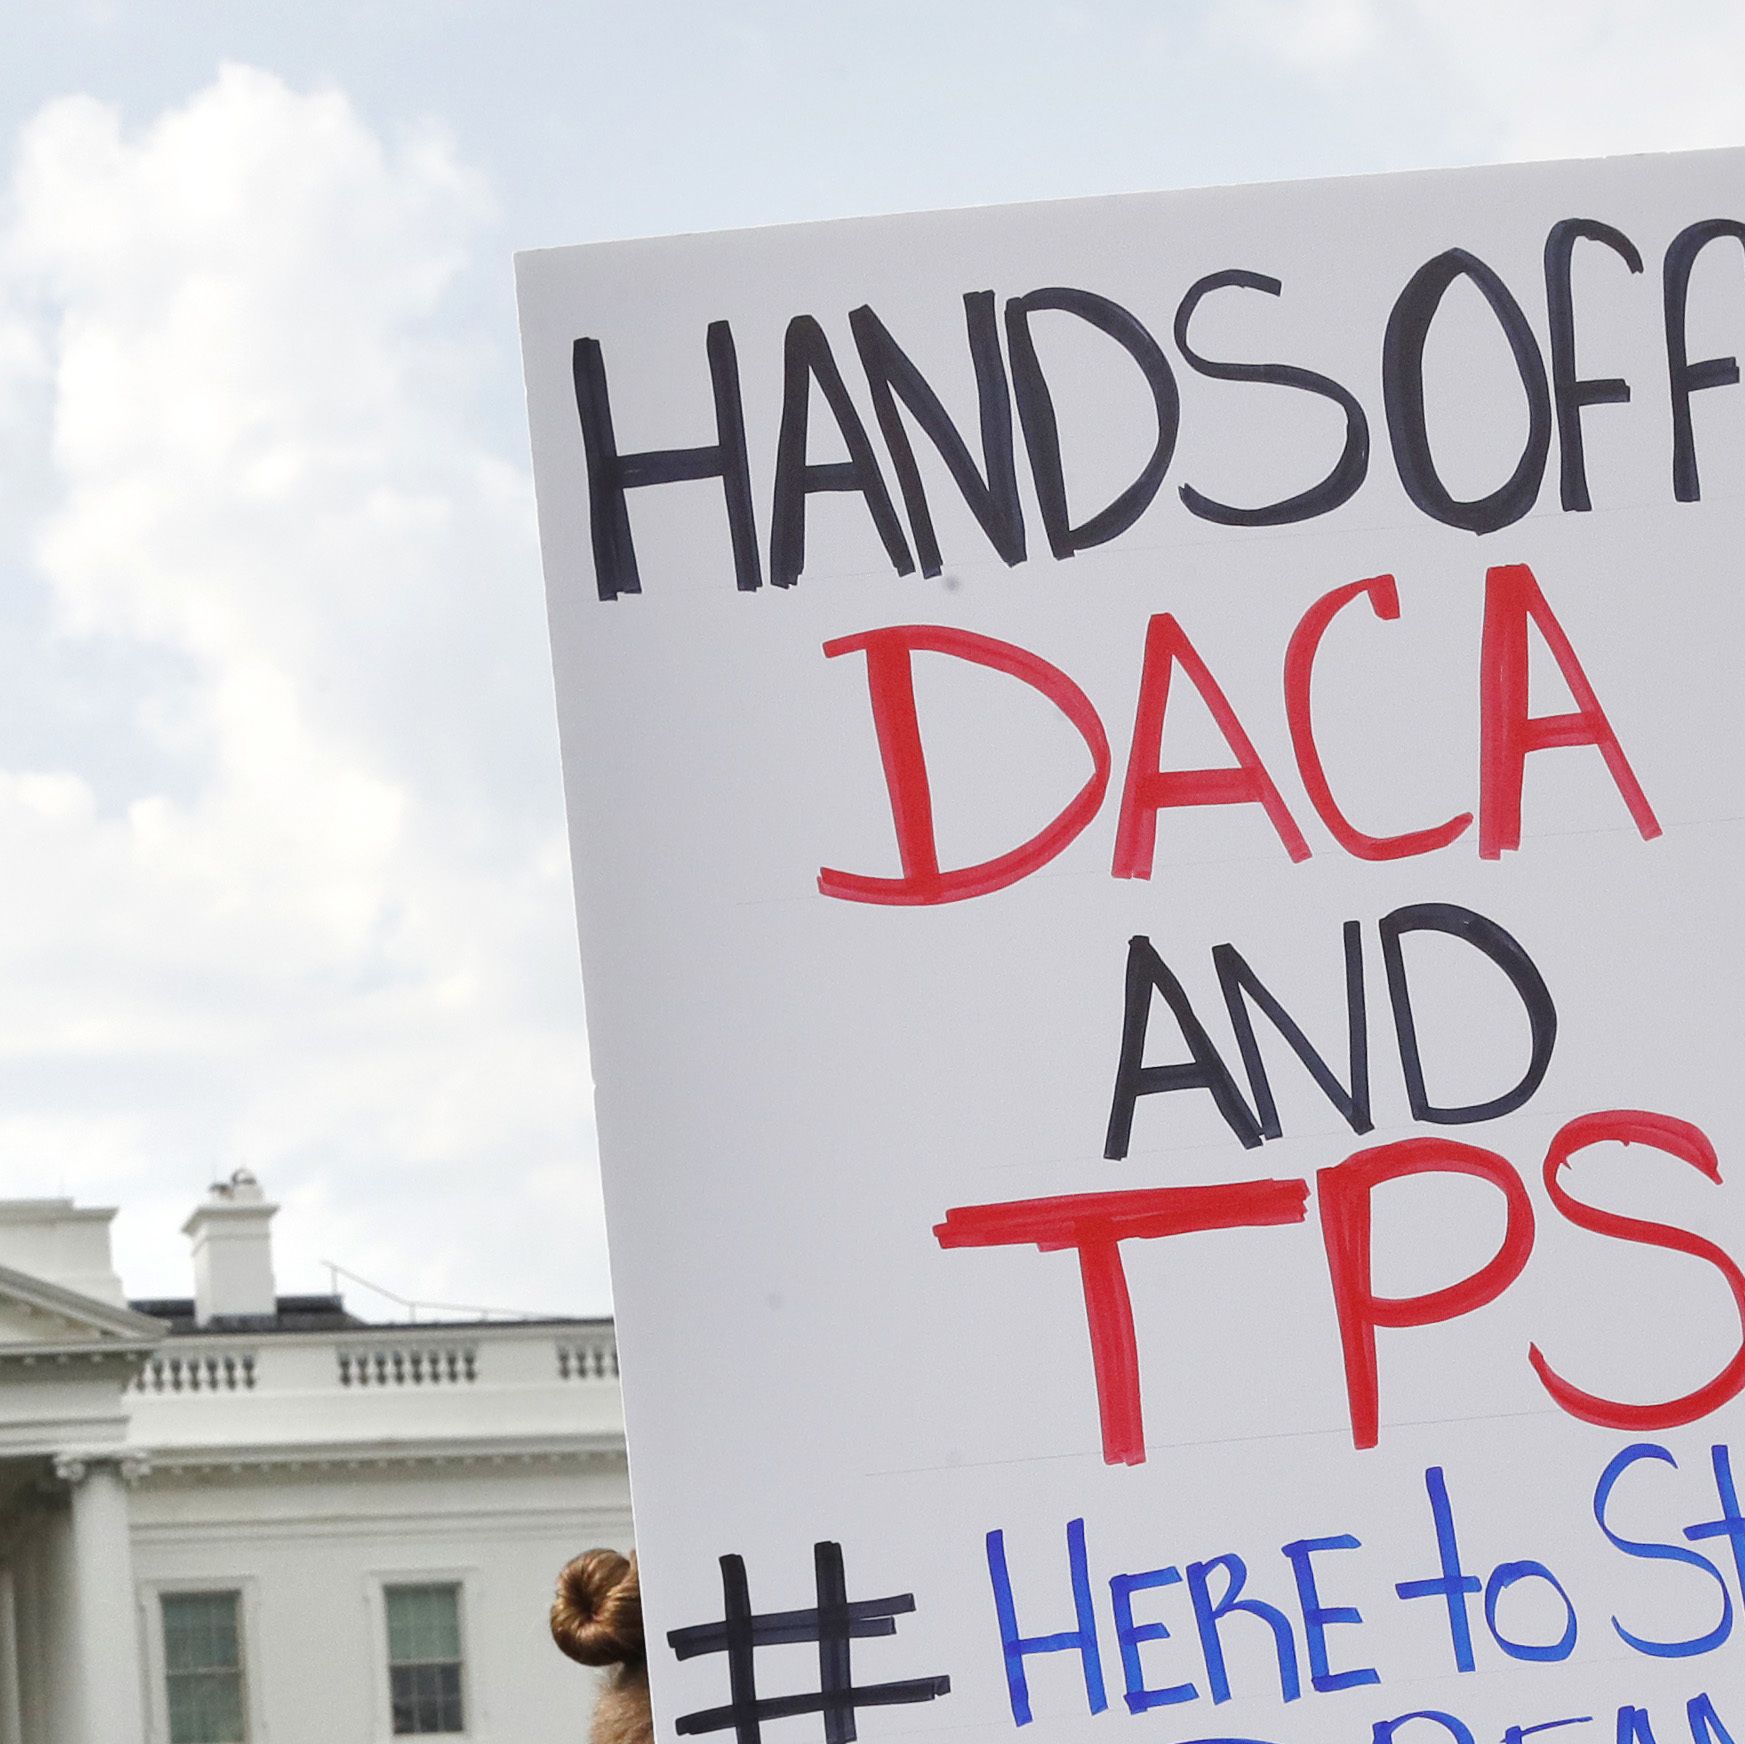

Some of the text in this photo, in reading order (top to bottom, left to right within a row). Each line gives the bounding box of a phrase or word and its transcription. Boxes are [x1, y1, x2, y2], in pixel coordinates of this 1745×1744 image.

[573, 268, 1370, 602] HANDS
[817, 563, 1663, 907] DACA
[1103, 902, 1558, 1162] AND
